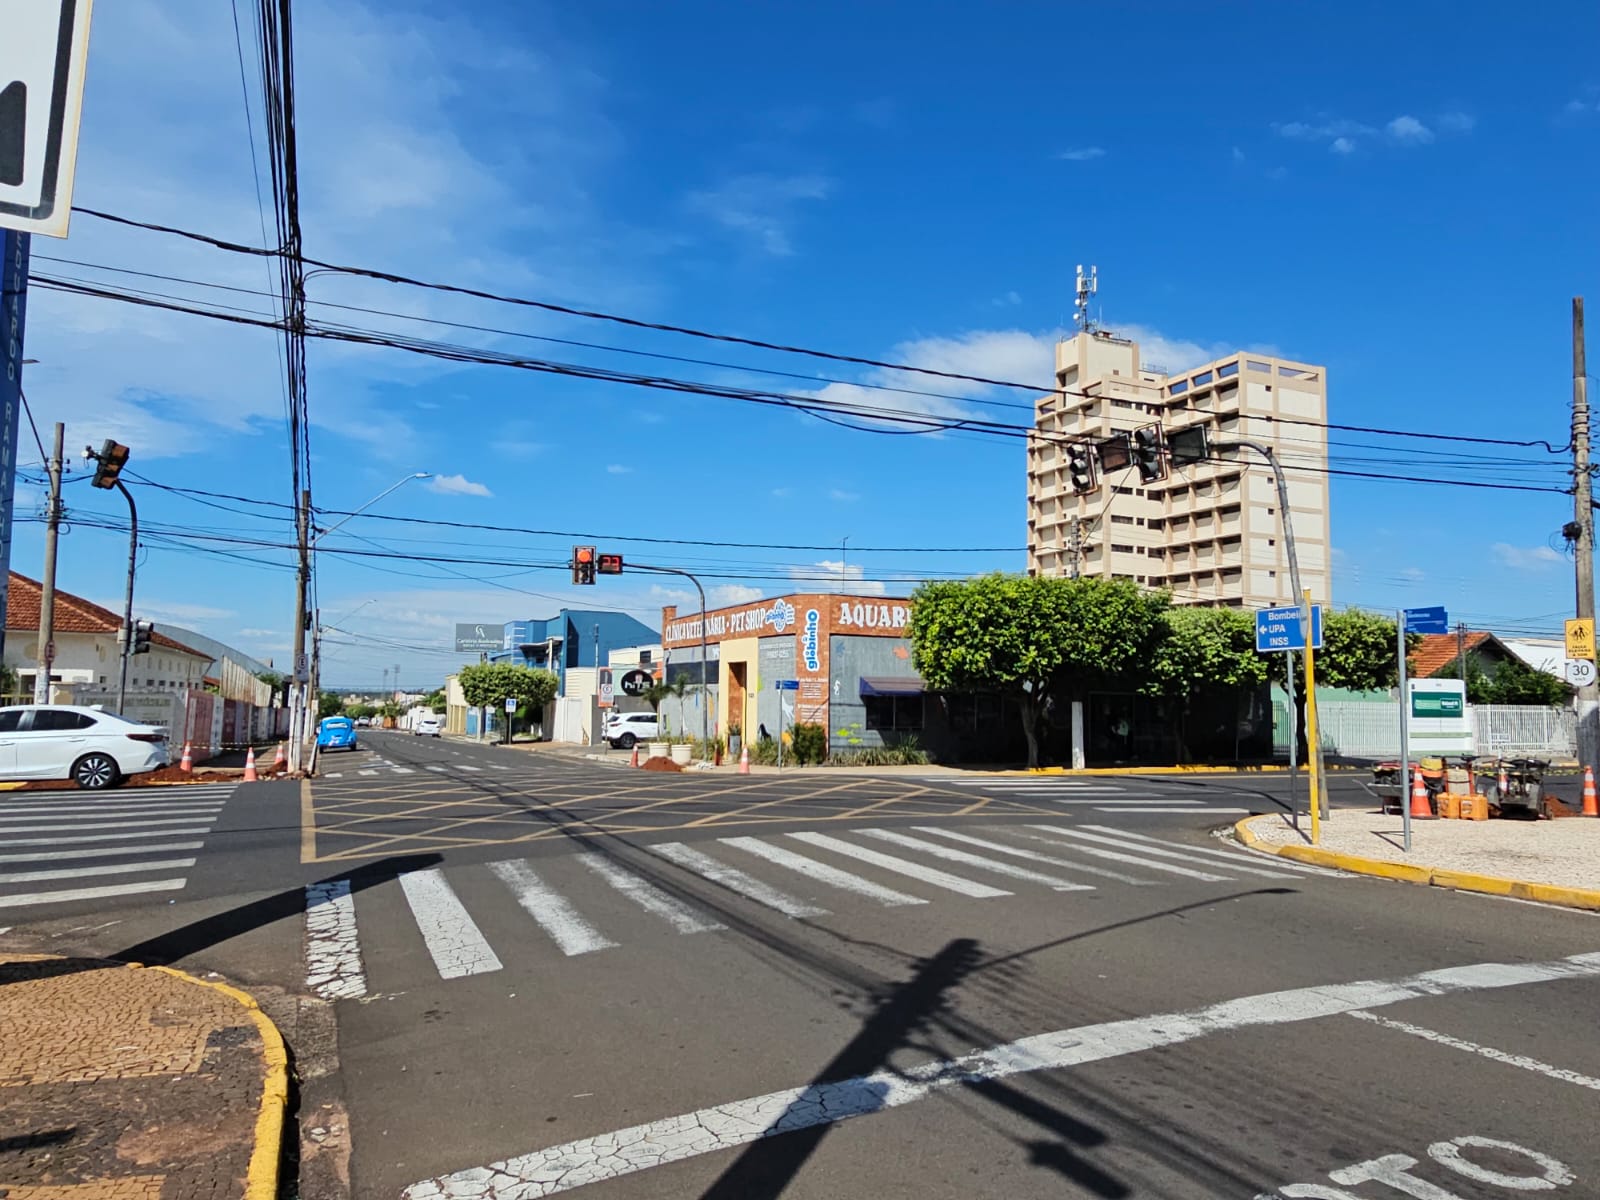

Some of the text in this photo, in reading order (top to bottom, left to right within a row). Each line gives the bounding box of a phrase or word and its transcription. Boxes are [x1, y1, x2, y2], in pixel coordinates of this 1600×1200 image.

[838, 602, 913, 628] AQUARI
[1268, 611, 1300, 621] Bombei
[686, 614, 726, 640] VETENÁRIA
[730, 611, 745, 633] PET
[745, 607, 766, 630] SHOP
[1268, 624, 1286, 633] UPA
[1269, 637, 1289, 646] INSS
[1572, 665, 1589, 676] 30
[1253, 1135, 1577, 1200] TO
